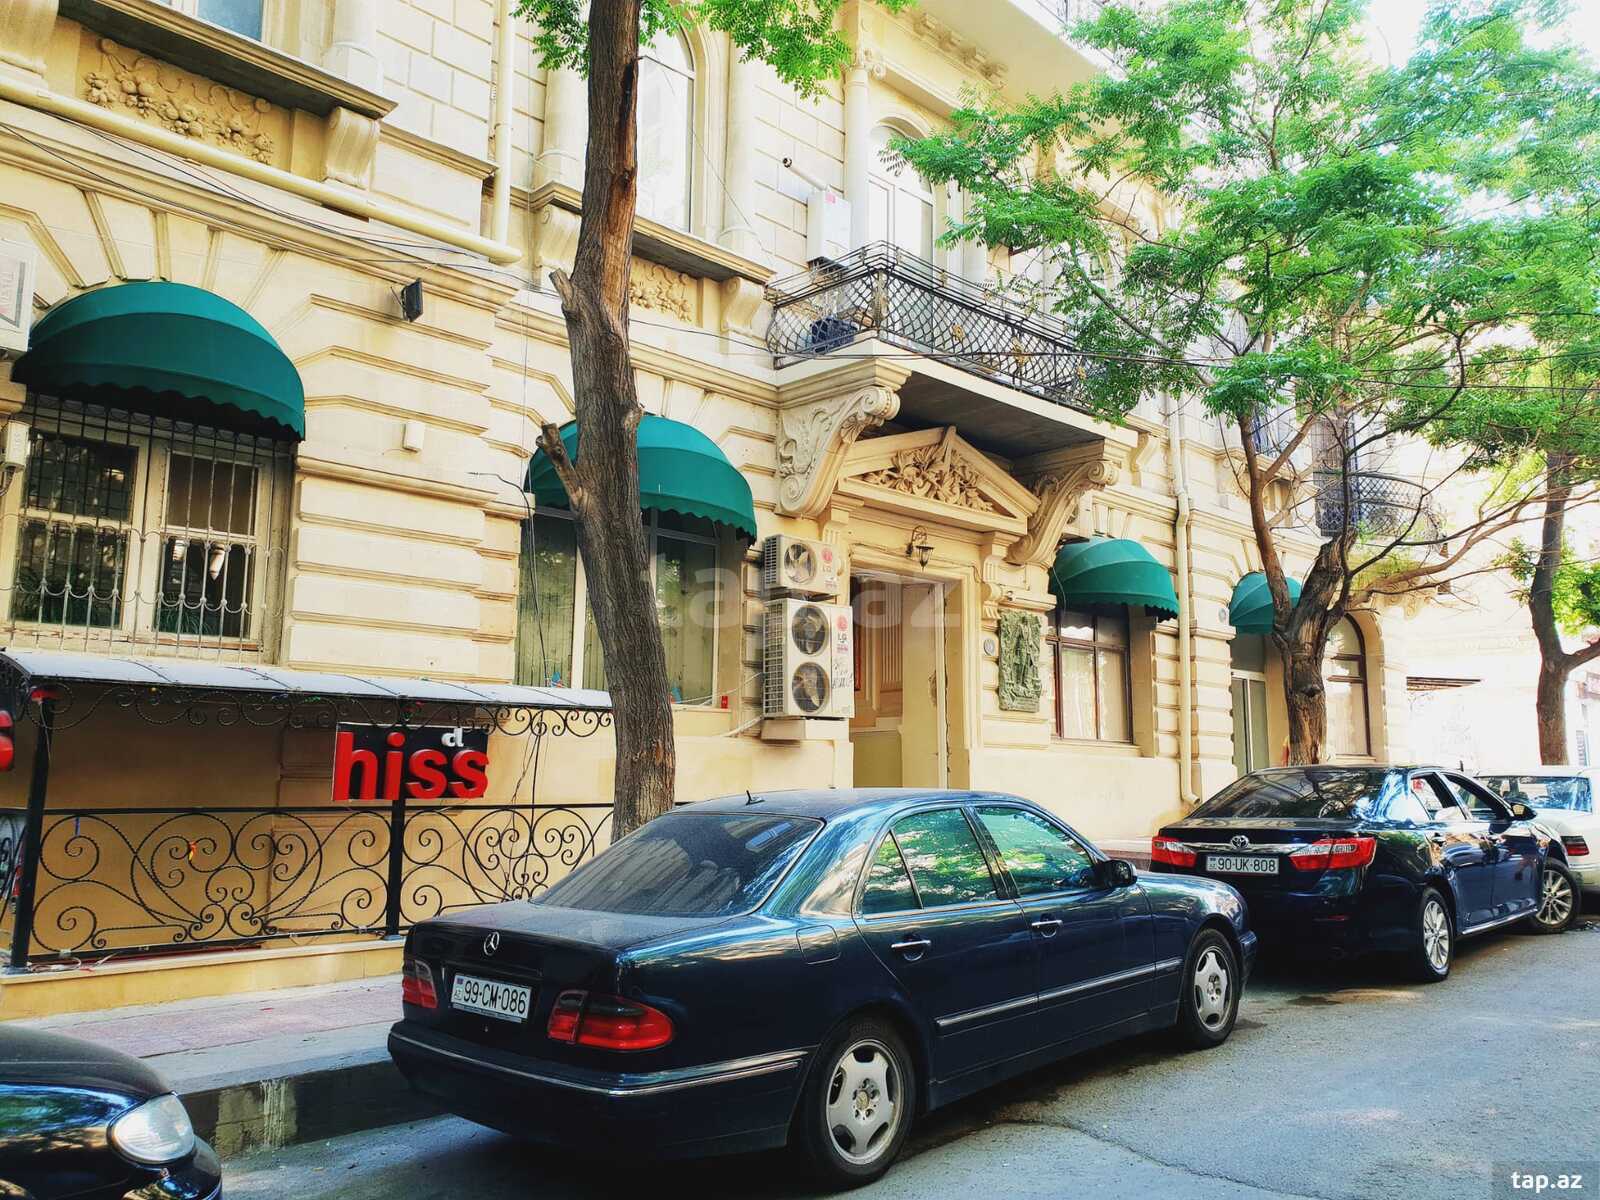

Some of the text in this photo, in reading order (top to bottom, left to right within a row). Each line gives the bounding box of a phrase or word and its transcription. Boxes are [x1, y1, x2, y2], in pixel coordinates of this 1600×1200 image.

[333, 731, 489, 800] hiss
[1218, 858, 1276, 872] 90-UK-808
[464, 980, 527, 1014] 99-CM-086
